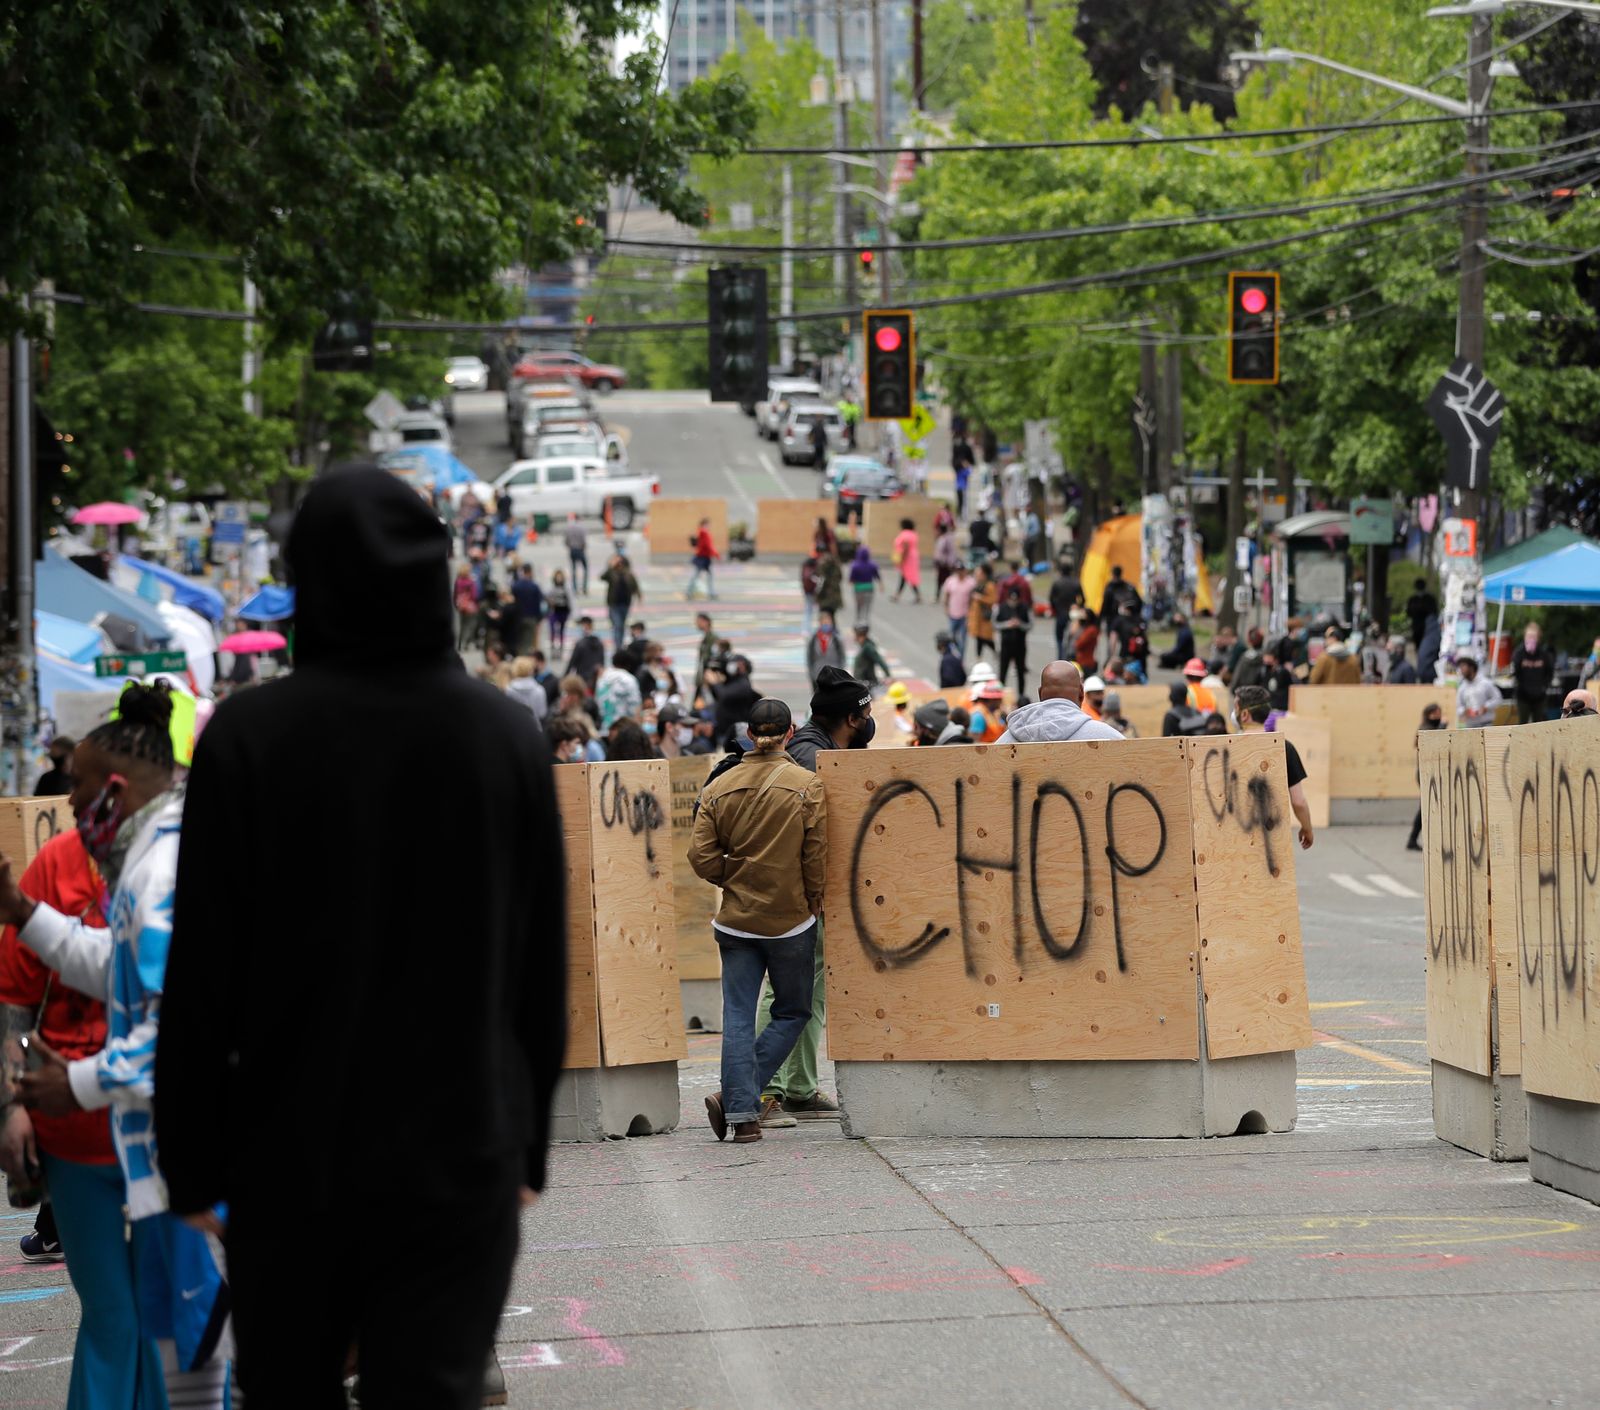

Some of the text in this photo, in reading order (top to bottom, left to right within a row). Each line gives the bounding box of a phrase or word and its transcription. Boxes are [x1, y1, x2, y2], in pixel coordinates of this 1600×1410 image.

[858, 694, 873, 706] SECU
[850, 773, 1167, 980] CHOP
[1428, 751, 1485, 973] CHOP
[1518, 750, 1599, 1032] CHOP
